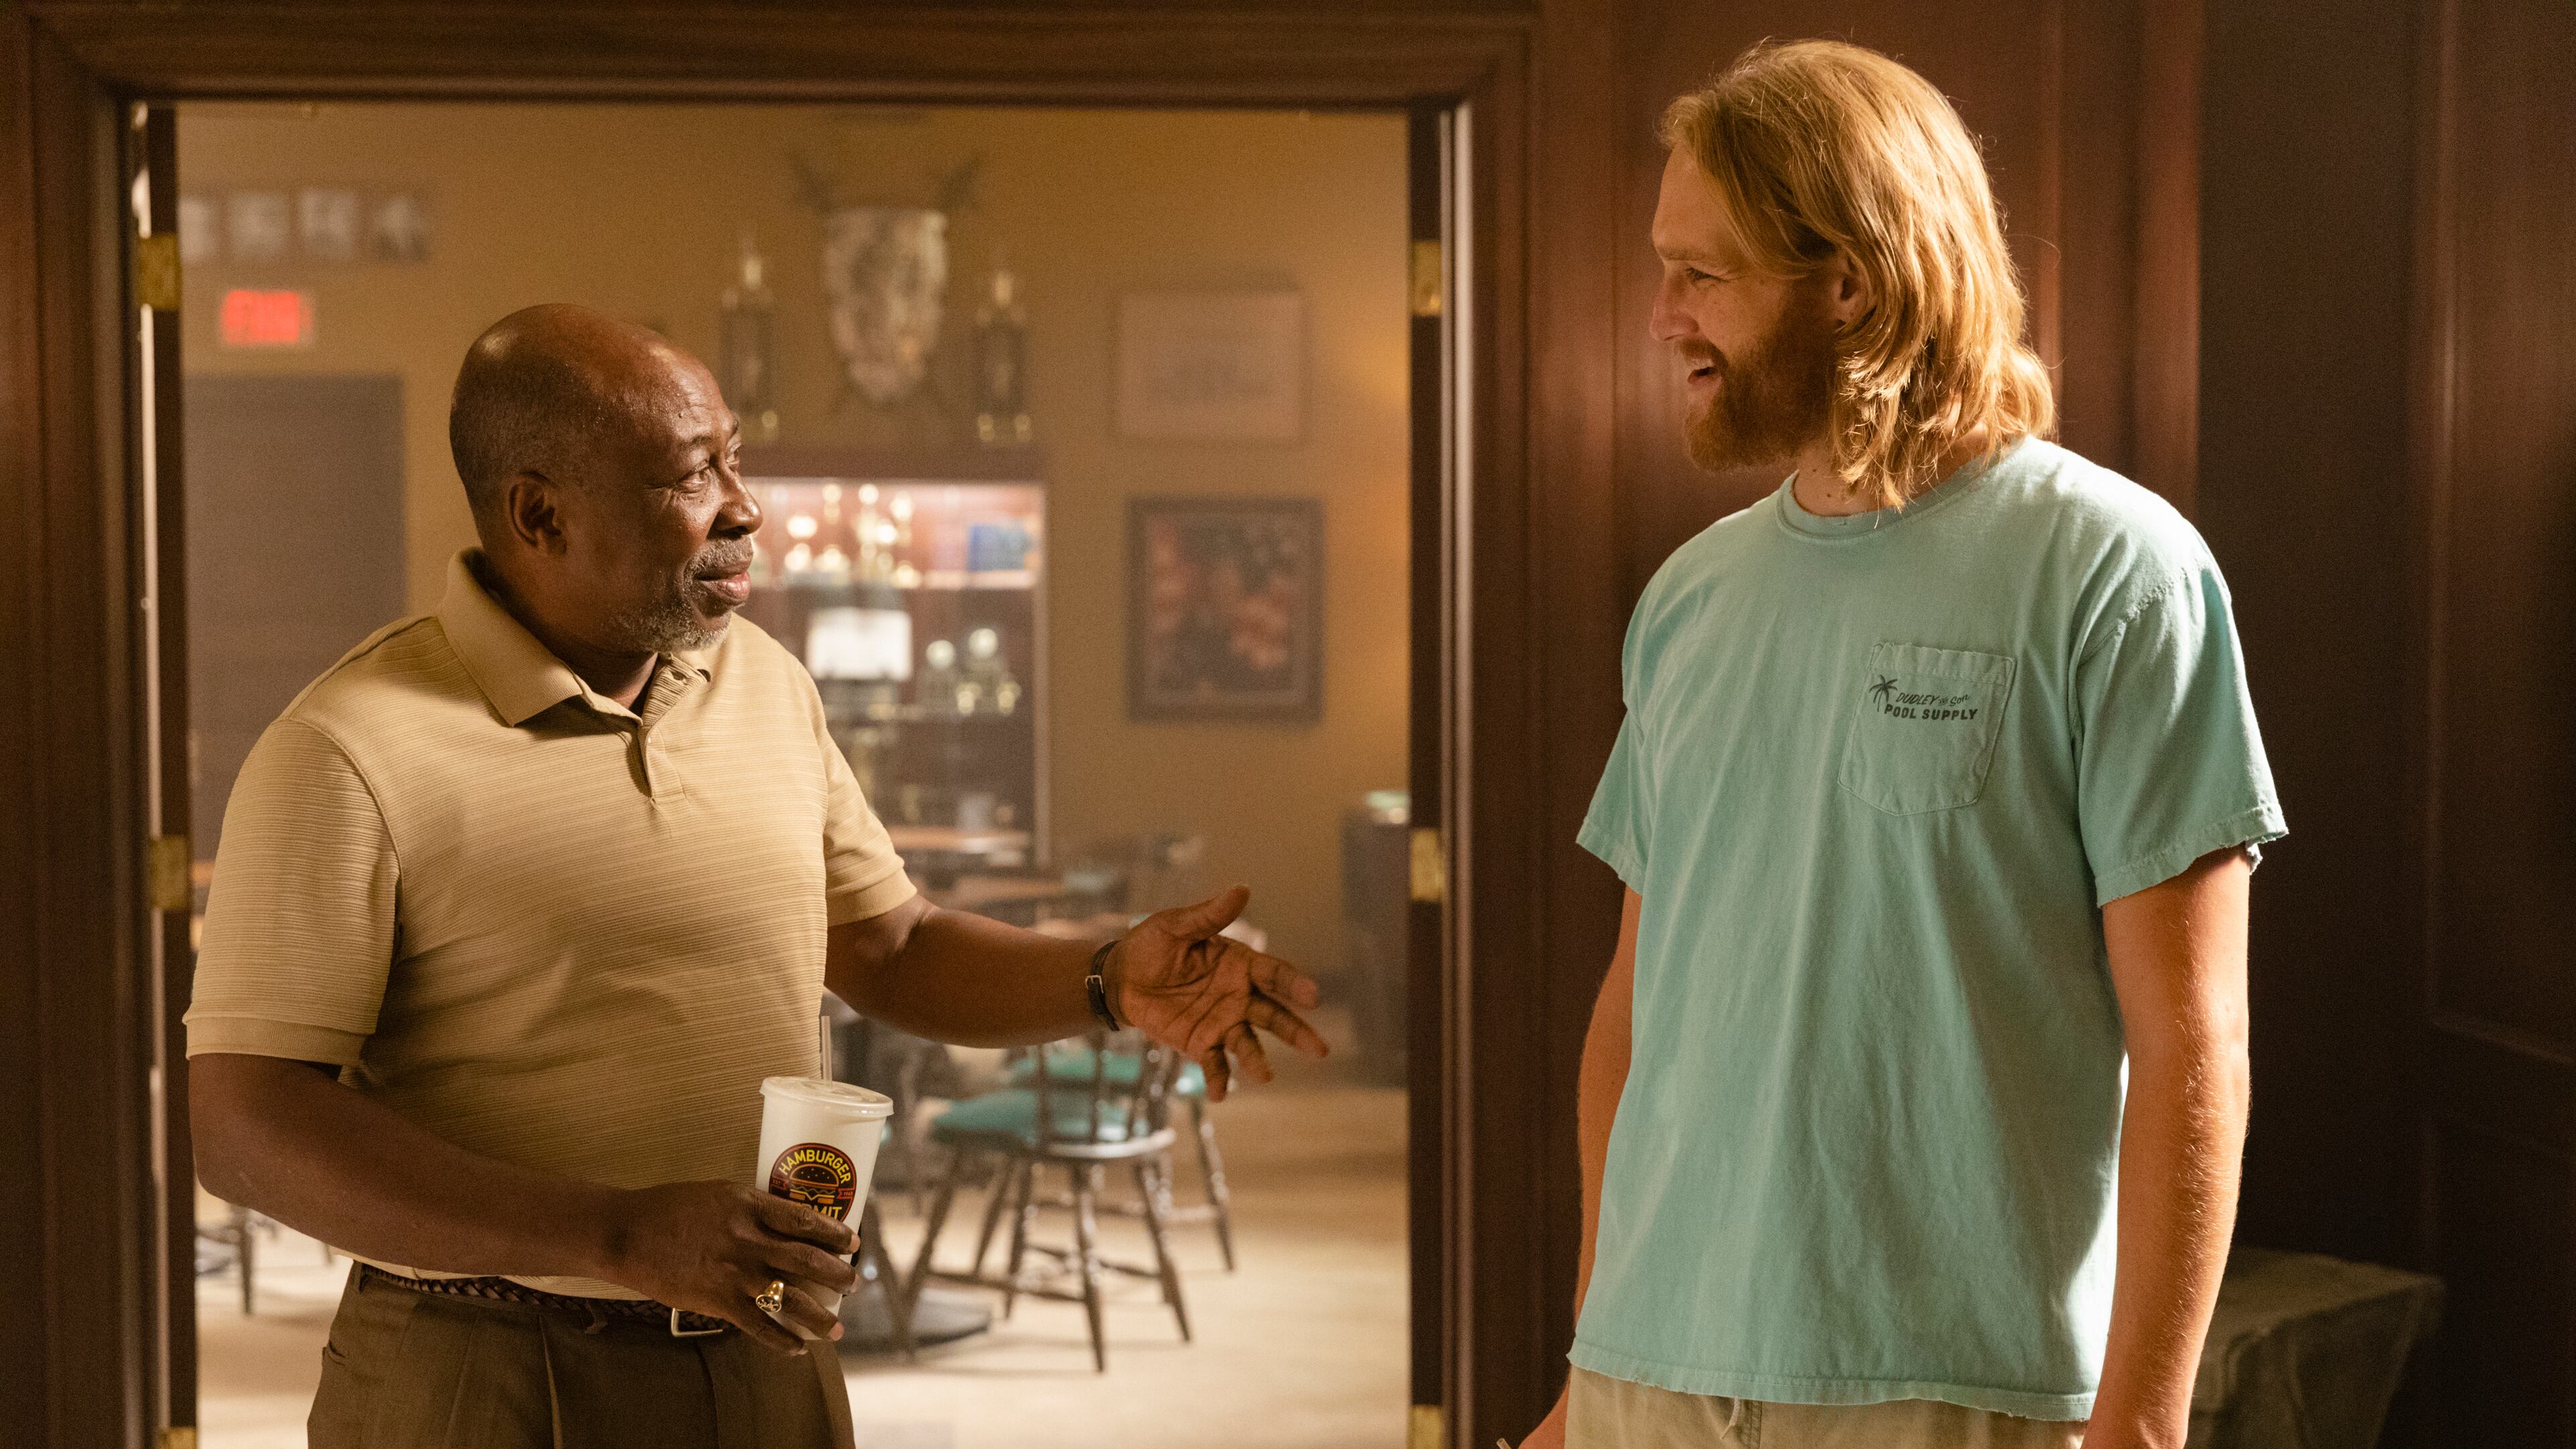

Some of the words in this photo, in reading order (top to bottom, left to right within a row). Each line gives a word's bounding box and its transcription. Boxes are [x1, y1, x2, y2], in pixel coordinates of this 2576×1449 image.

[1895, 692, 1940, 705] DUDLEY
[1884, 703, 1917, 719] POOL
[1921, 708, 1978, 720] SUPPLY
[778, 1149, 851, 1184] HAMBURGER
